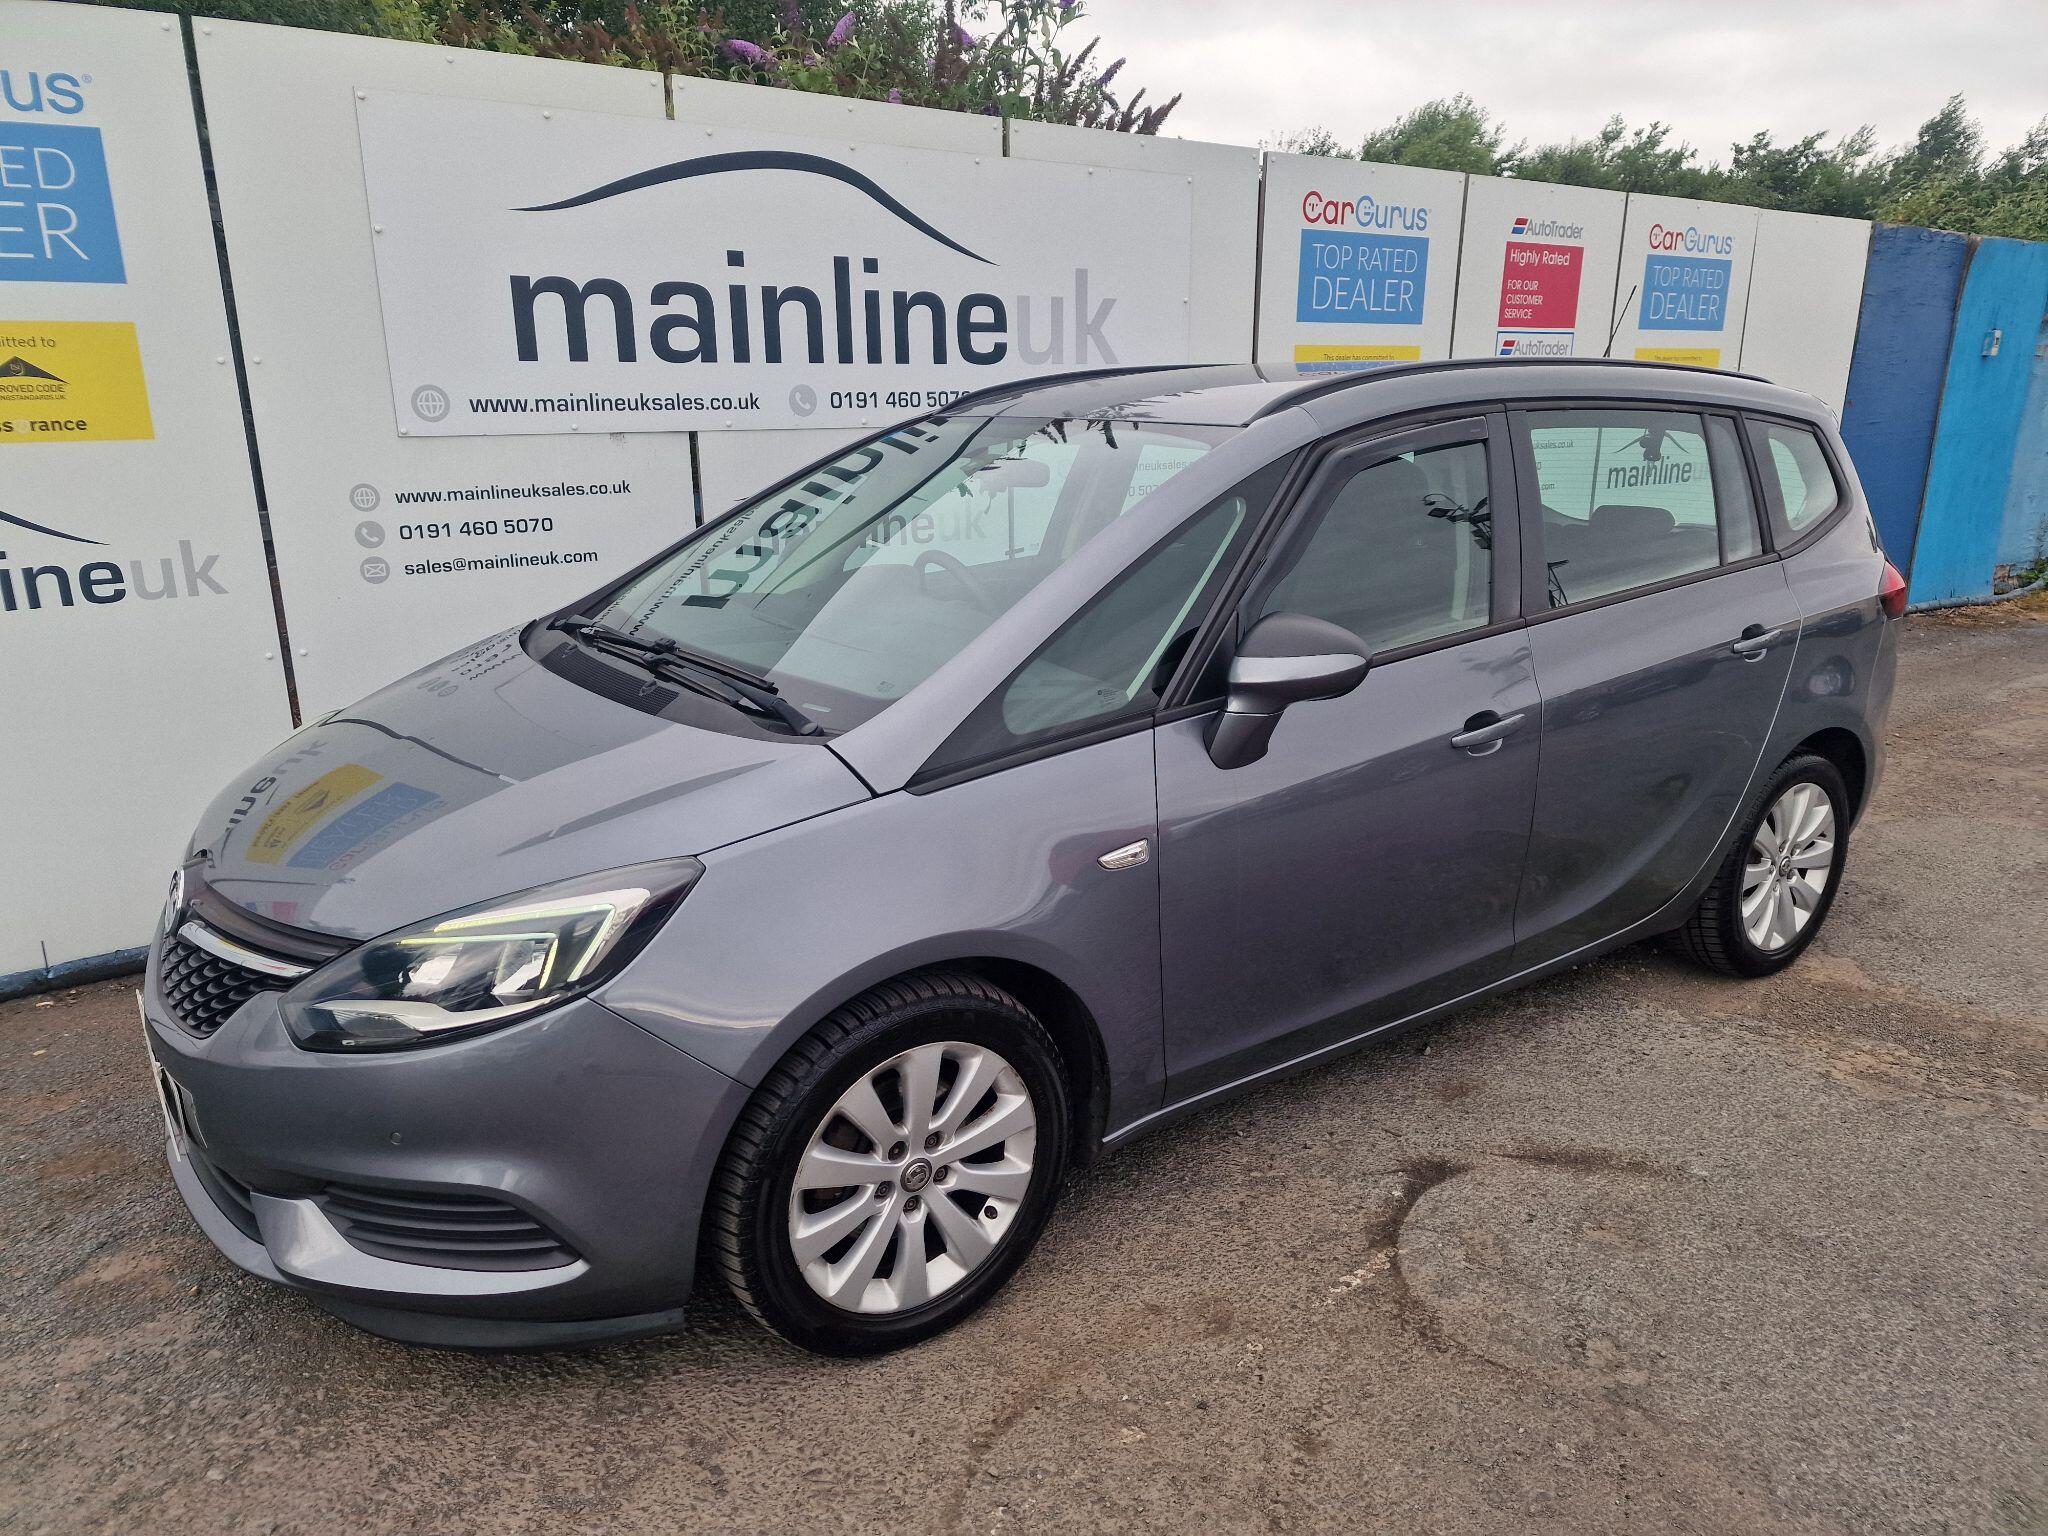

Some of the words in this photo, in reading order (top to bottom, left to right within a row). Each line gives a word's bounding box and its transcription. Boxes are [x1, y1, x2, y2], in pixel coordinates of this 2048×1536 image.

[1302, 190, 1428, 231] CarGurus
[1525, 219, 1584, 240] AutoTrader
[1649, 223, 1733, 255] CarGurus
[1312, 243, 1353, 270] TOP
[1357, 246, 1418, 273] RATED
[1510, 248, 1541, 267] Highly
[1542, 250, 1571, 266] Rated
[1506, 279, 1521, 290] FOR
[1523, 280, 1539, 291] OUR
[1653, 265, 1680, 287] TOP
[1682, 267, 1724, 290] RATED
[1312, 275, 1414, 312] DEALER
[1505, 294, 1543, 305] CUSTOMER
[509, 249, 1121, 366] mainlineuk
[1504, 308, 1532, 319] SERVICE
[1649, 291, 1720, 321] DEALER
[41, 336, 56, 348] to
[1513, 340, 1569, 356] AutoTrader
[469, 392, 761, 413] www.mainlineuksales.co.uk
[830, 391, 878, 409] 0191
[885, 391, 921, 408] 460
[395, 480, 631, 504] www.mainlineuksales.co.uk
[400, 523, 451, 540] 0191
[459, 520, 498, 537] 460
[504, 517, 553, 534] 5070
[404, 550, 598, 575] sales@mainlineuk.com
